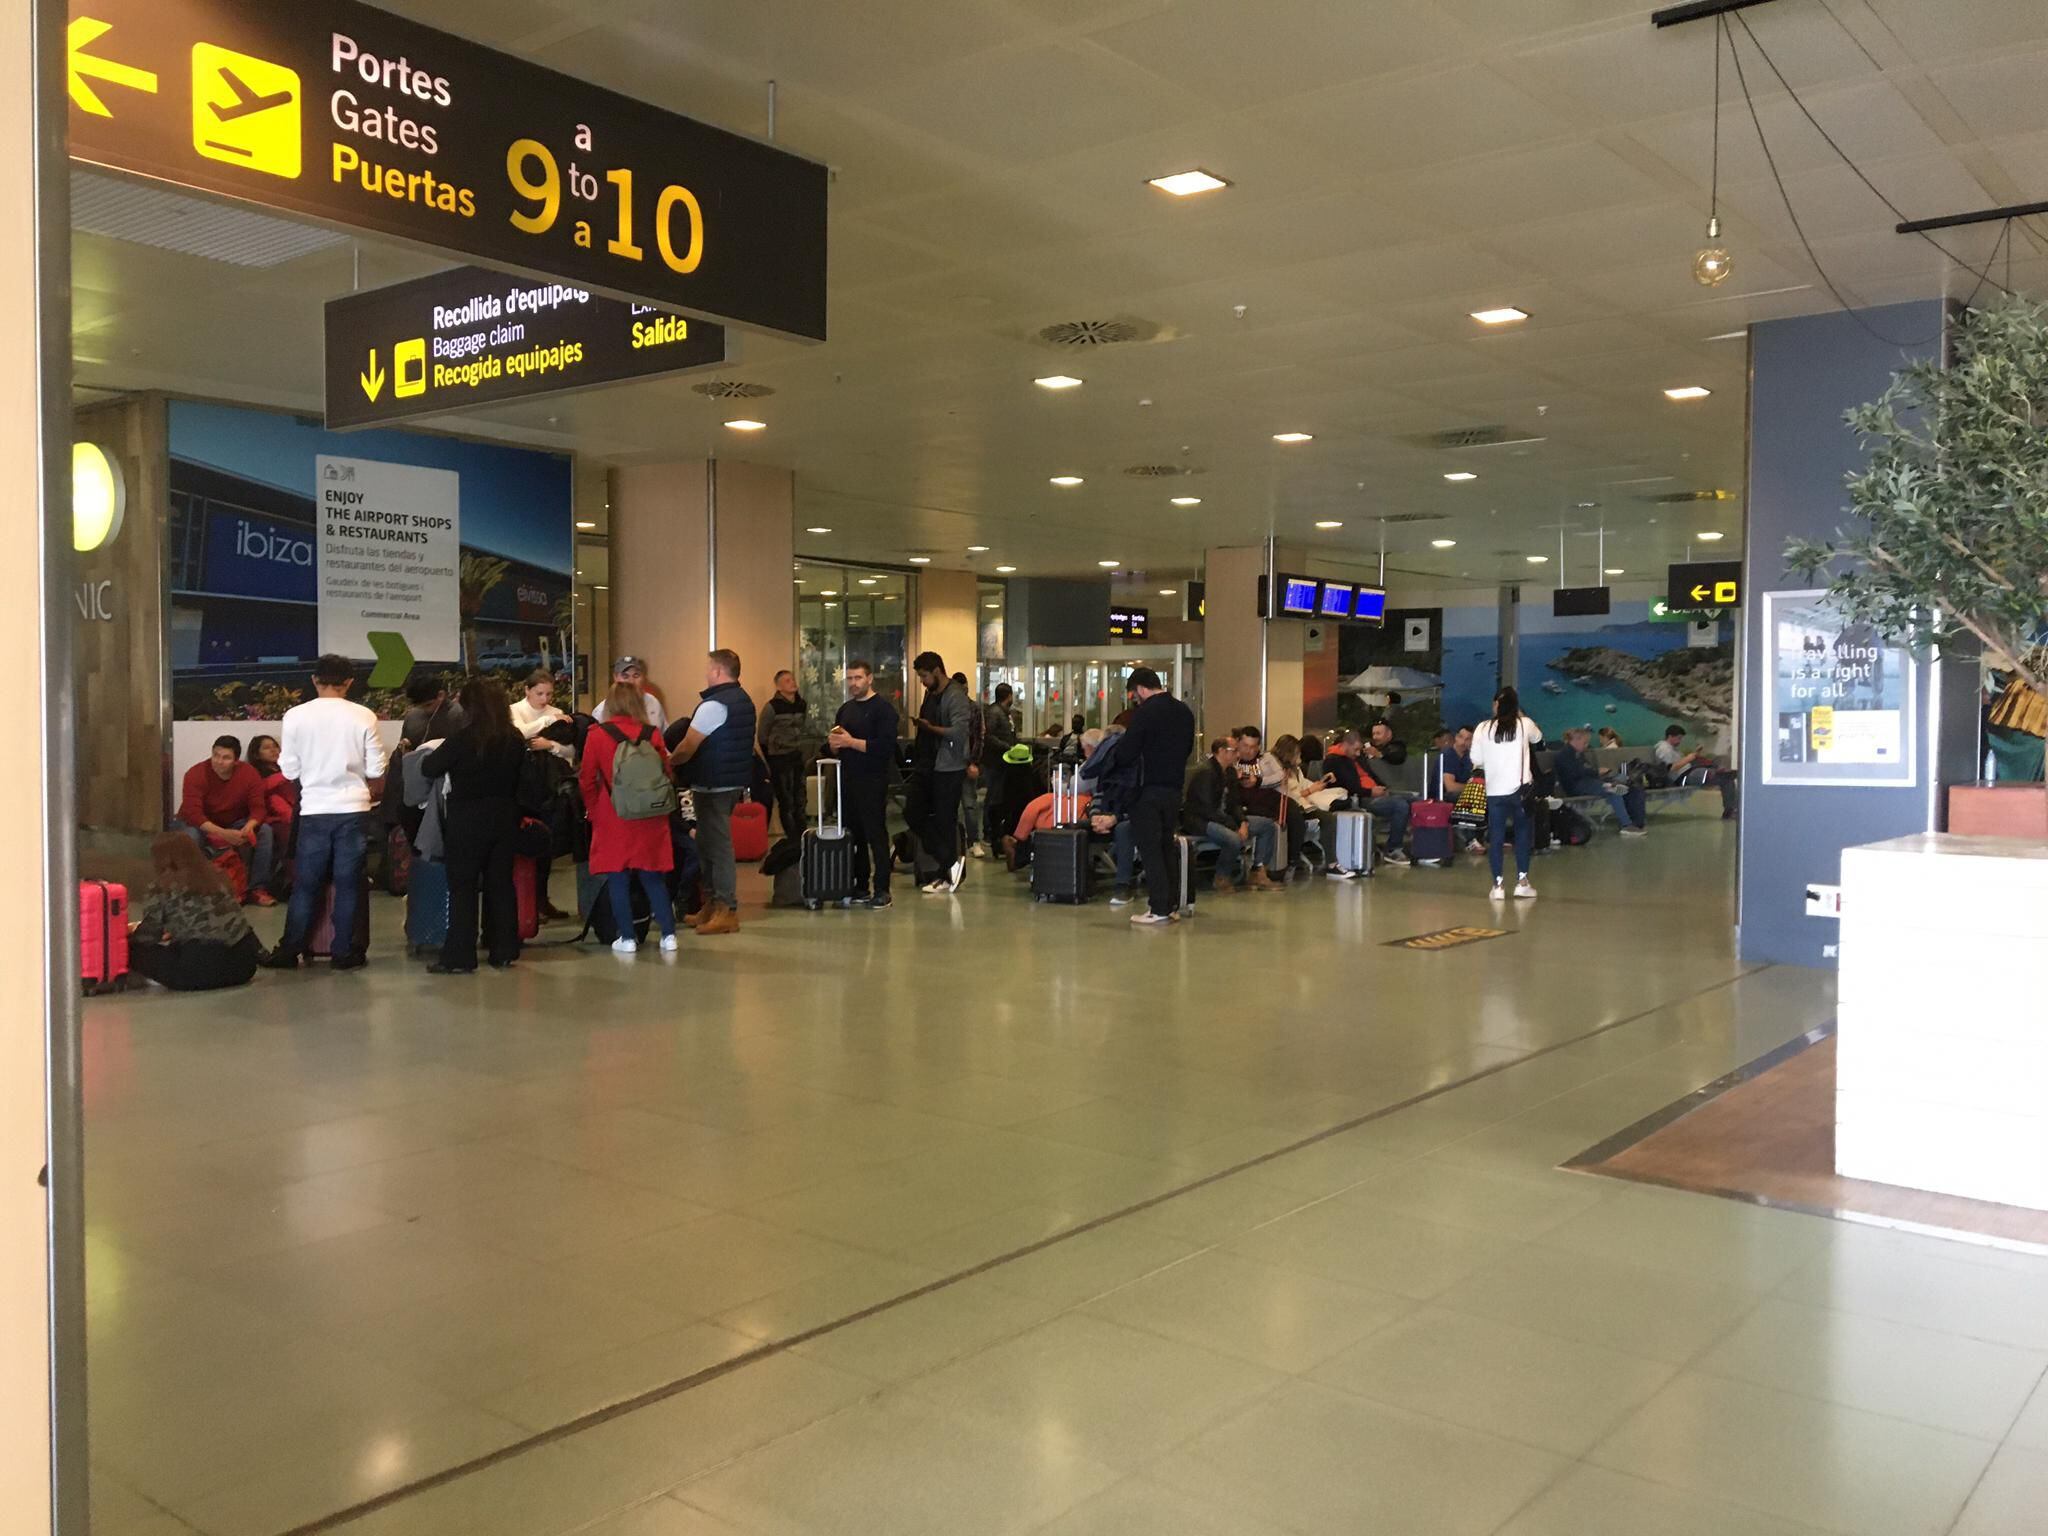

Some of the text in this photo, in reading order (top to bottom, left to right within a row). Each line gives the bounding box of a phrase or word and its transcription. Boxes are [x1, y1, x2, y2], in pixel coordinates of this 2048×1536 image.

[332, 32, 451, 107] Portes
[331, 89, 438, 155] Gates
[574, 123, 592, 151] a
[332, 142, 476, 218] Puertas
[506, 138, 704, 274] 9 to 10
[574, 220, 591, 249] a
[433, 283, 590, 330] Recollida d'equipatg
[433, 321, 525, 359] Baggage claim
[631, 315, 688, 348] Salida
[434, 339, 583, 387] Recogida equipajes
[325, 489, 364, 505] ENJOY
[325, 506, 452, 530] THE AIRPORT SHOPS
[326, 523, 428, 544] & RESTAURANTS
[236, 520, 313, 567] ibiza
[326, 543, 424, 563] Disfruta las tiendas y
[326, 559, 454, 577] restaurantes del aeropuerto
[1811, 668, 1820, 679] a
[1826, 662, 1871, 682] right
[1792, 682, 1845, 698] for all
